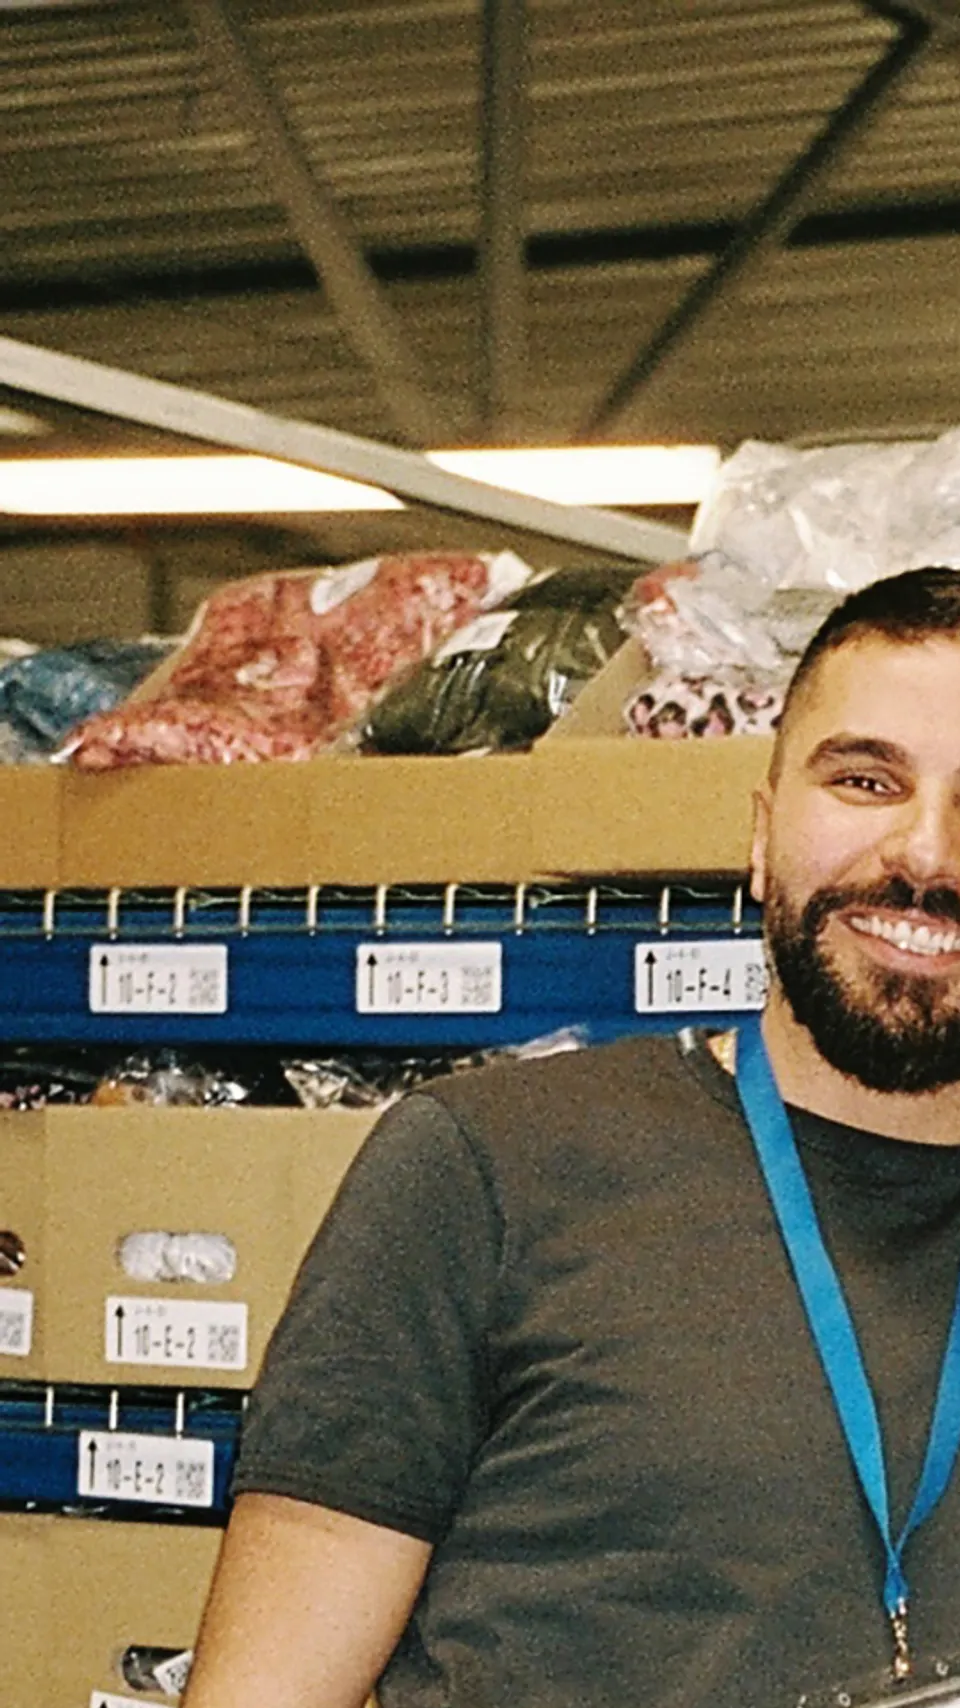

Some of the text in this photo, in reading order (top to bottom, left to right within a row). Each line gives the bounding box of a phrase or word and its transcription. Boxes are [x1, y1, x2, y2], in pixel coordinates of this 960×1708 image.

[667, 966, 733, 1004] 10-F-4
[135, 1323, 197, 1360] 10-E-2
[106, 1458, 166, 1495] 10-E-2
